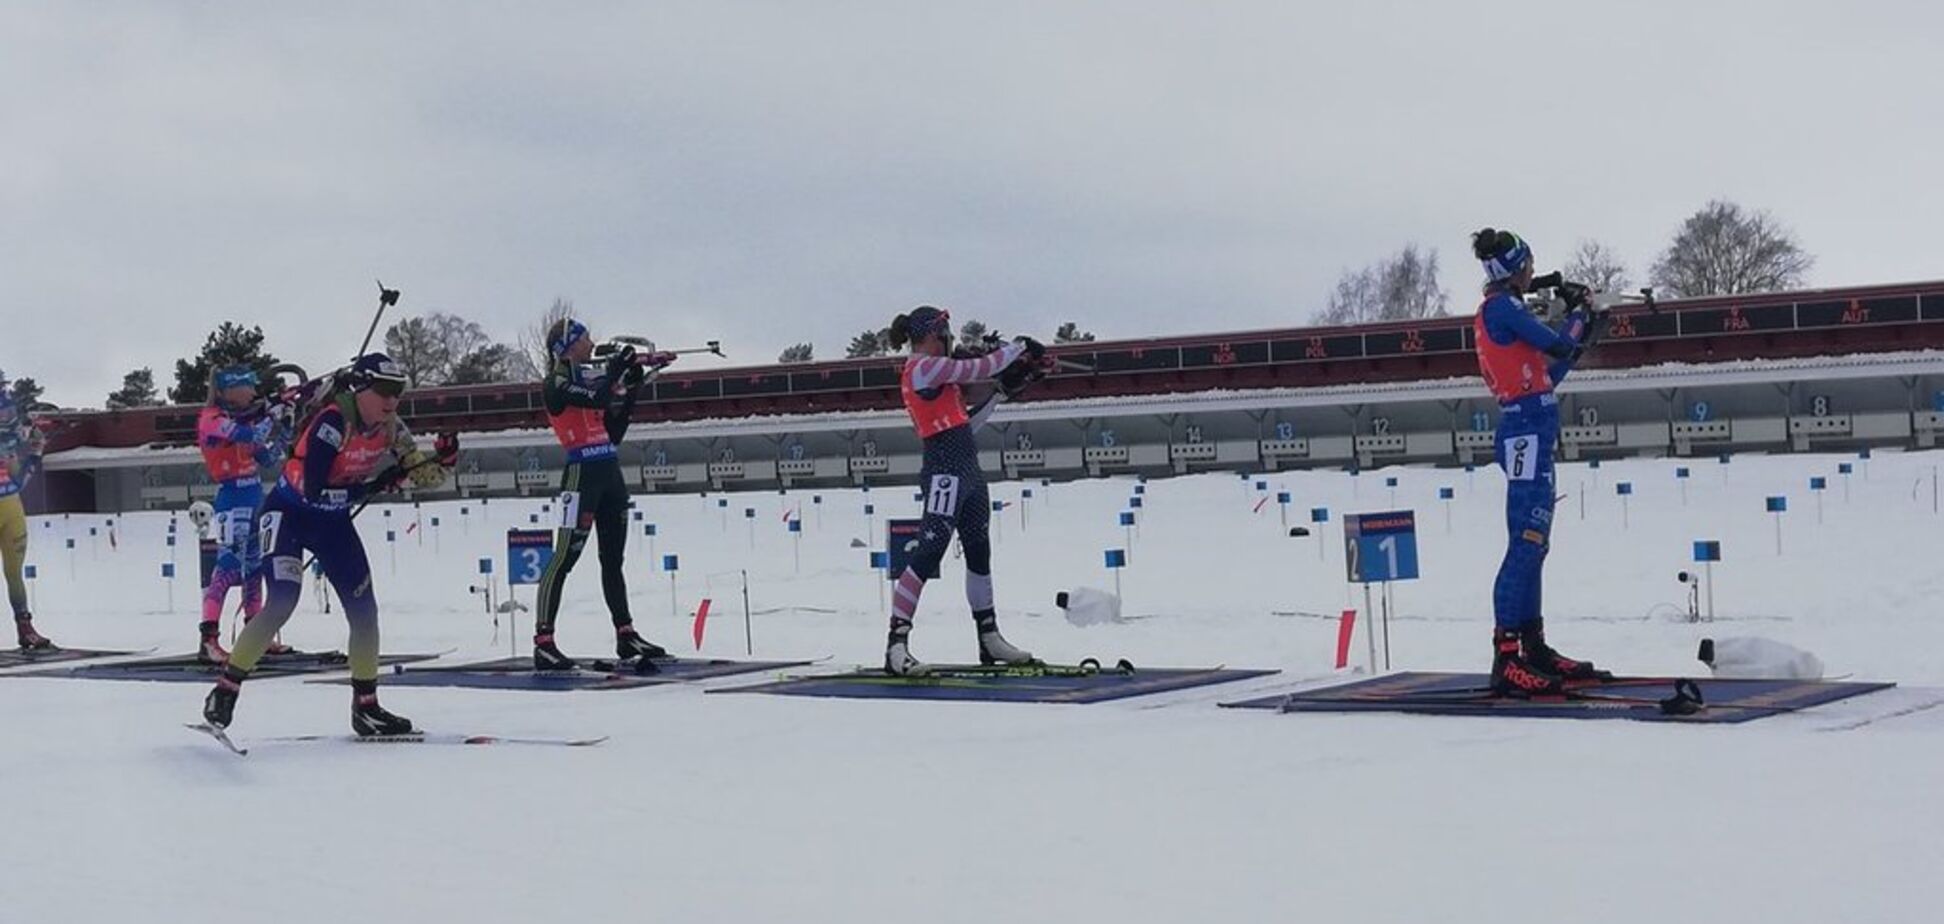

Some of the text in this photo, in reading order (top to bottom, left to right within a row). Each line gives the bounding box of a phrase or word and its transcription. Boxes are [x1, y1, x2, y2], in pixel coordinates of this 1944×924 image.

[1724, 317, 1750, 330] FRA
[1842, 308, 1871, 322] AUT
[1695, 402, 1707, 420] 9
[1814, 397, 1827, 415] 8
[1474, 413, 1488, 431] 11
[1580, 408, 1597, 426] 10
[1187, 427, 1201, 443] 14
[1278, 424, 1292, 440] 13
[1374, 419, 1388, 435] 12
[1514, 453, 1525, 477] 6
[934, 491, 950, 513] 11
[521, 548, 541, 581] 3
[1349, 538, 1360, 580] 2
[1378, 535, 1398, 578] 1
